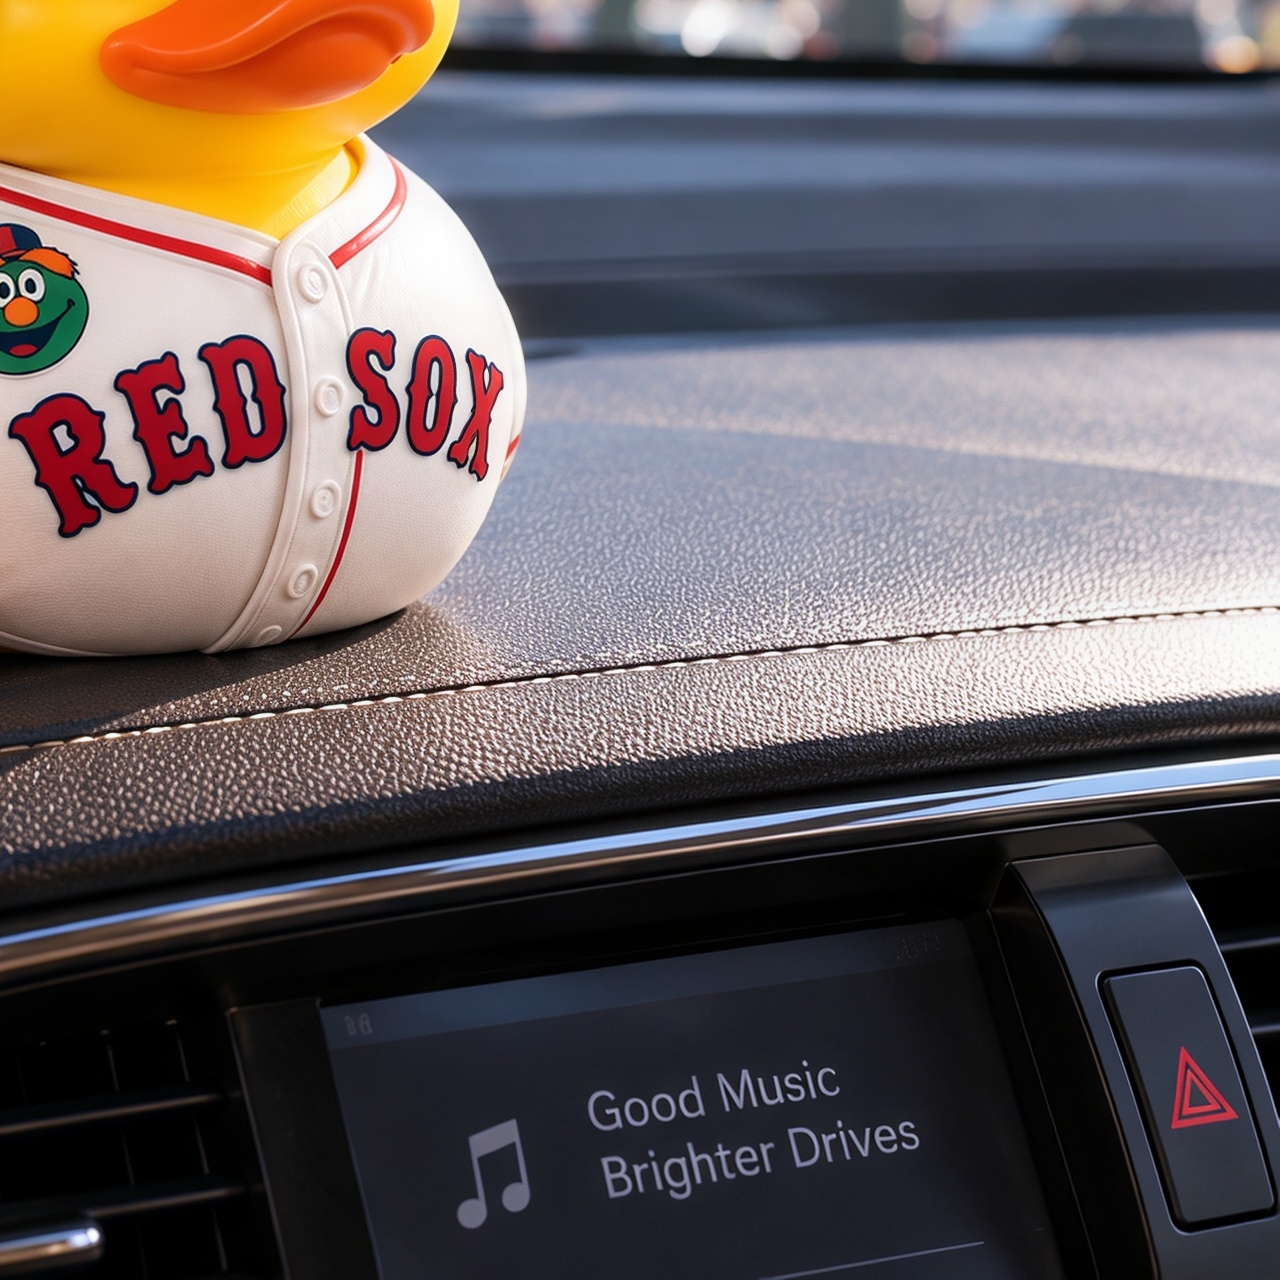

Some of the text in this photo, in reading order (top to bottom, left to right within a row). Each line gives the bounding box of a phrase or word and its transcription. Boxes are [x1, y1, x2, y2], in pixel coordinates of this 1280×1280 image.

[8, 327, 504, 538] RED SOX
[587, 1060, 841, 1131] Good Music
[600, 1120, 920, 1200] Brighter Drives
